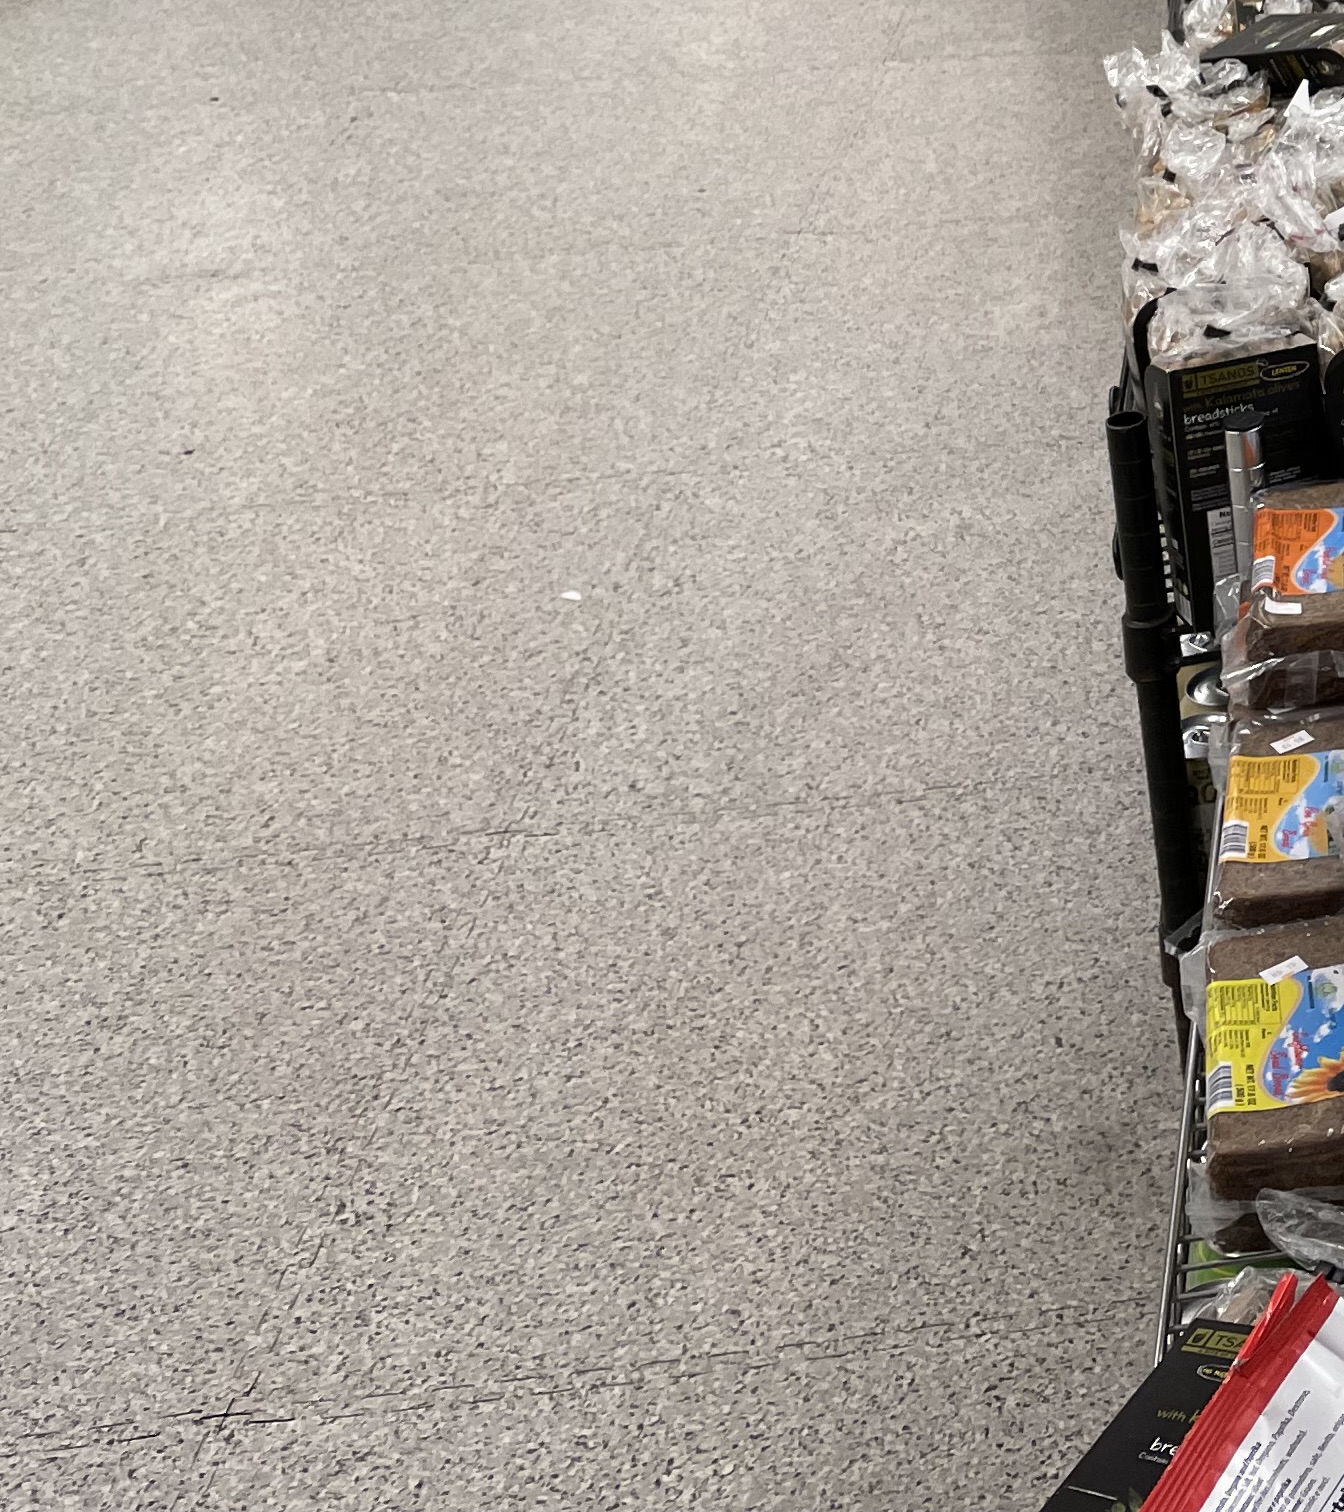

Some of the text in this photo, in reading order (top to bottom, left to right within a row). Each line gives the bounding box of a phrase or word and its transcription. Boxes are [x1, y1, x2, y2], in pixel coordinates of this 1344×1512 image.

[1201, 366, 1258, 387] TSANOS
[1182, 402, 1255, 426] breadsticks
[1215, 1333, 1248, 1349] TSA
[1156, 1408, 1187, 1422] with
